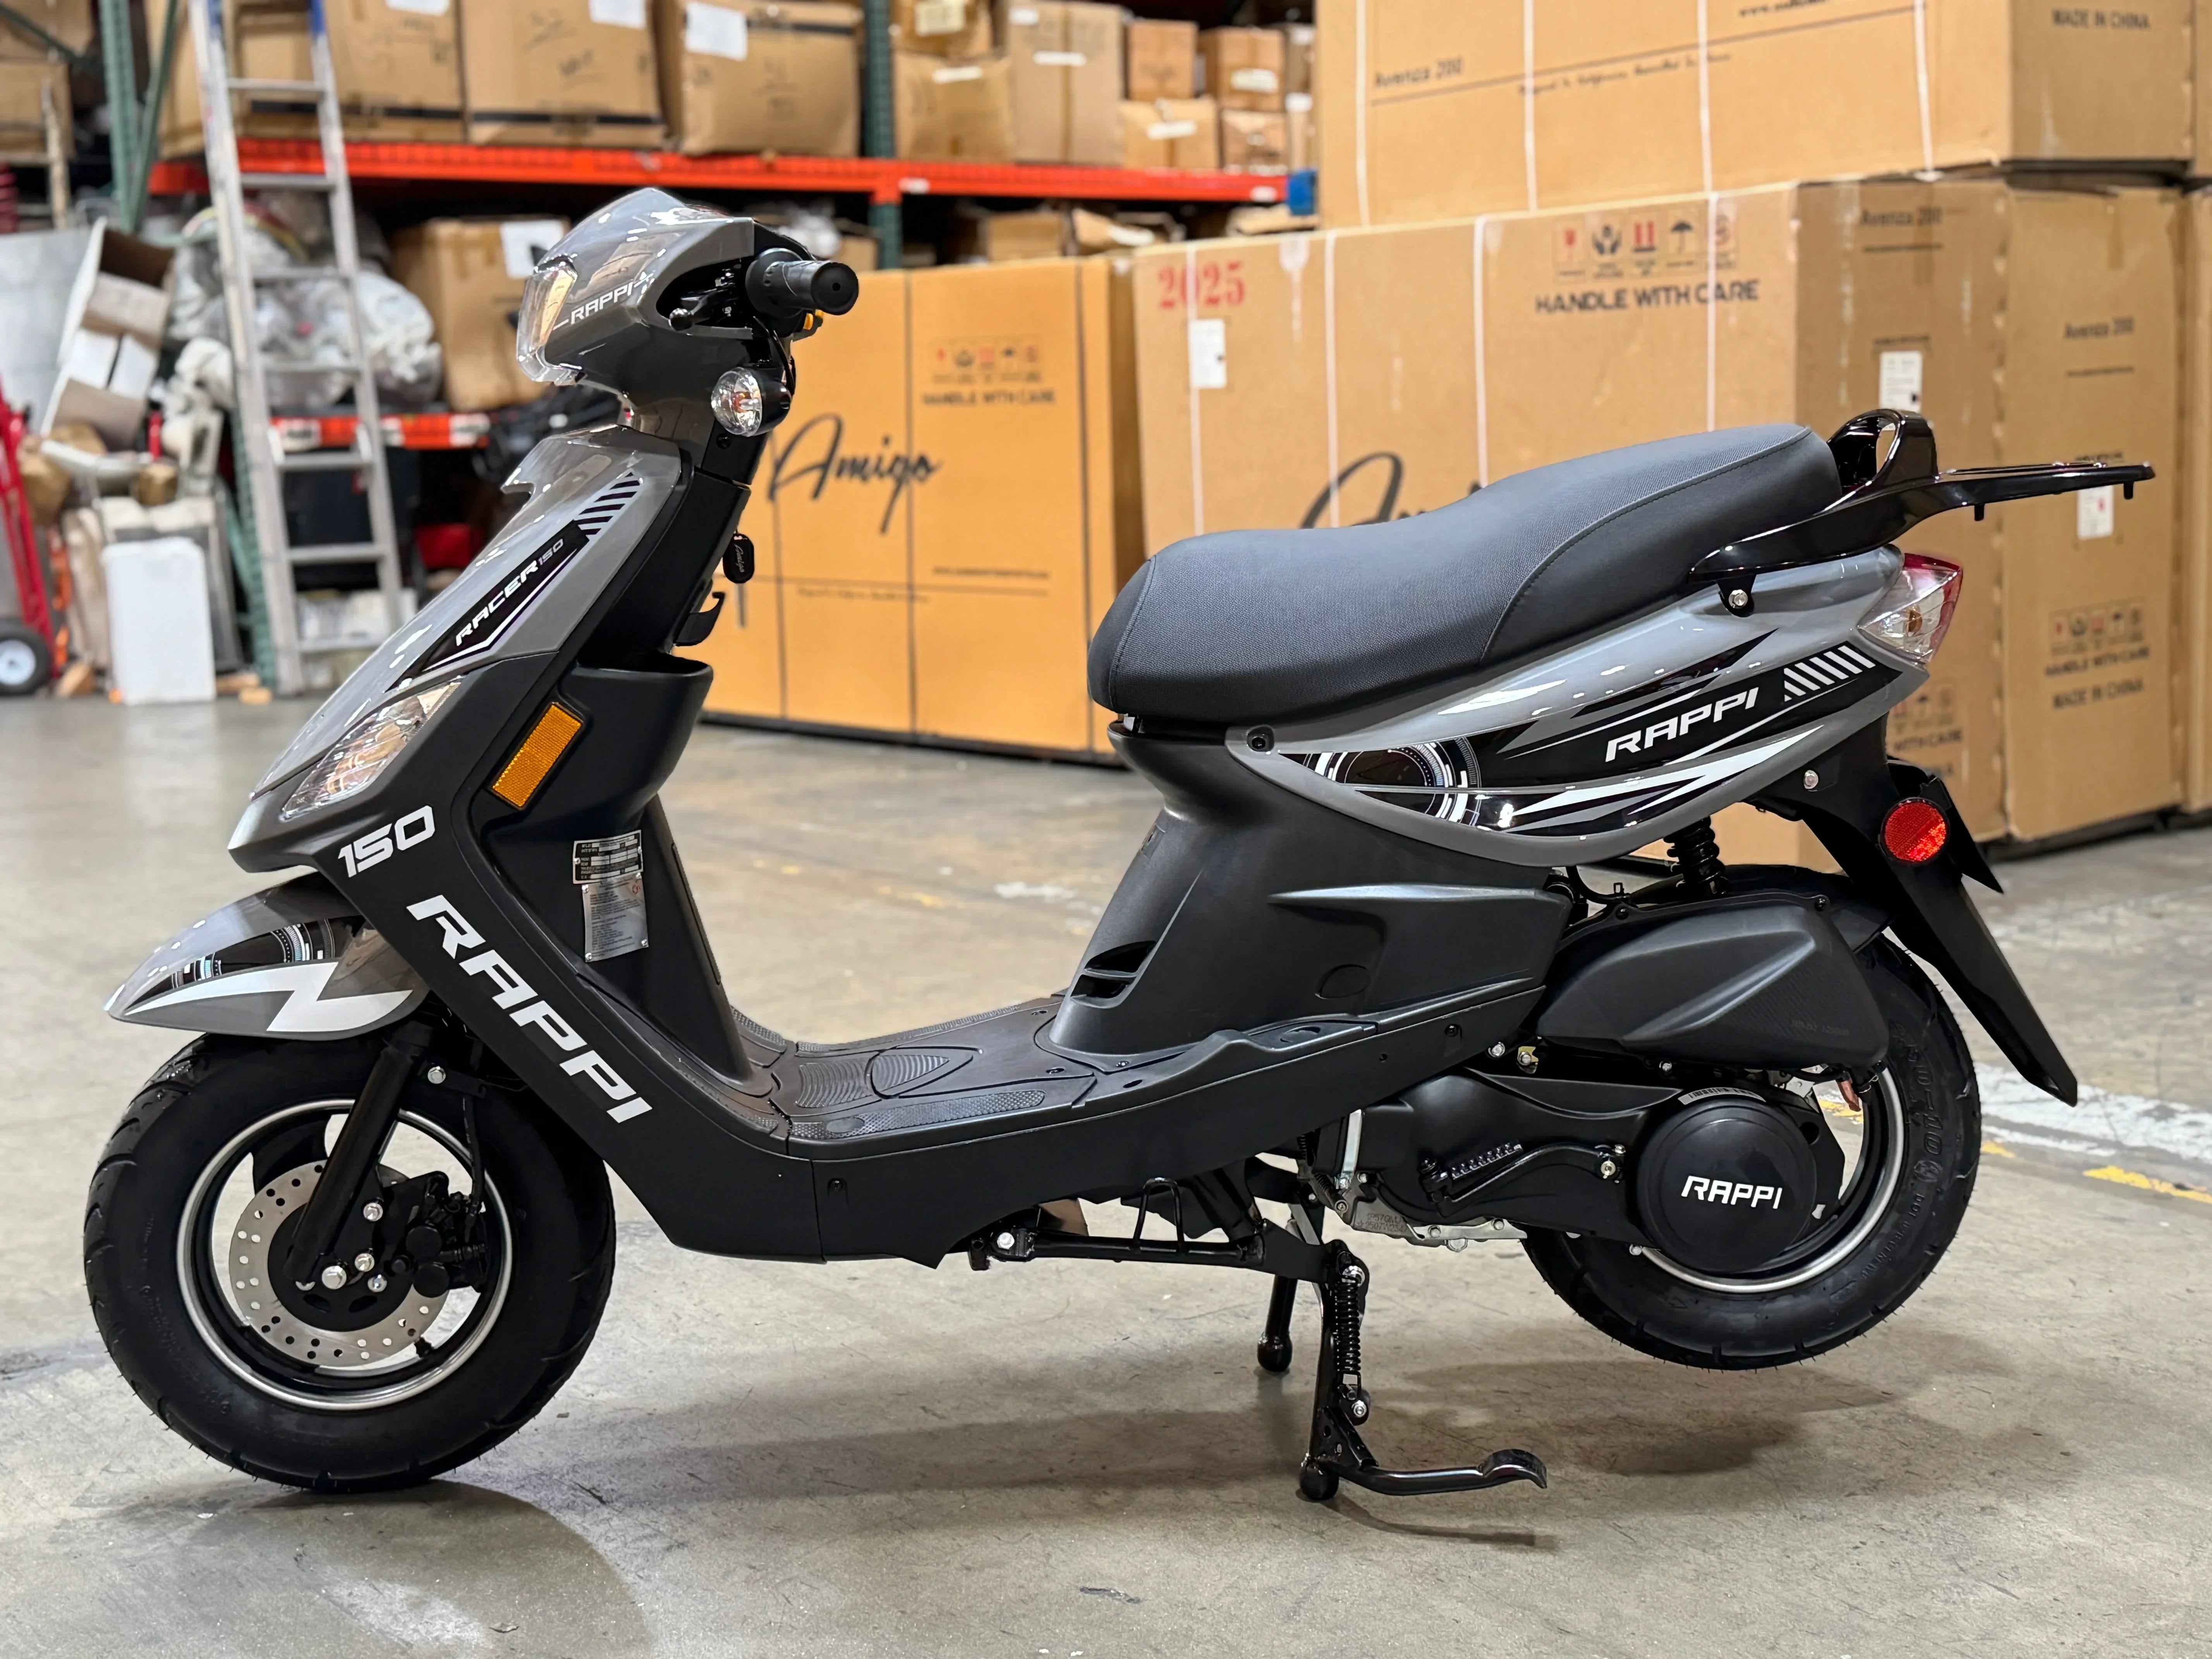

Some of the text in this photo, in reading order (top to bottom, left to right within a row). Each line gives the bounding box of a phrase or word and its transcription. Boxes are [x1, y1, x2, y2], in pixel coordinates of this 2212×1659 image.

[2052, 9, 2151, 30] MADE IN CHINA
[571, 282, 633, 325] RAPPI
[1158, 262, 1245, 309] 2025
[1535, 279, 1759, 314] HANDLE WITH CARE
[766, 412, 944, 535] Amigo
[455, 538, 564, 646] RACER 150
[1605, 687, 1759, 762] RAPPI
[338, 805, 435, 878] 150
[406, 895, 653, 1123] RAPPI
[1681, 1175, 1782, 1209] RAPPI
